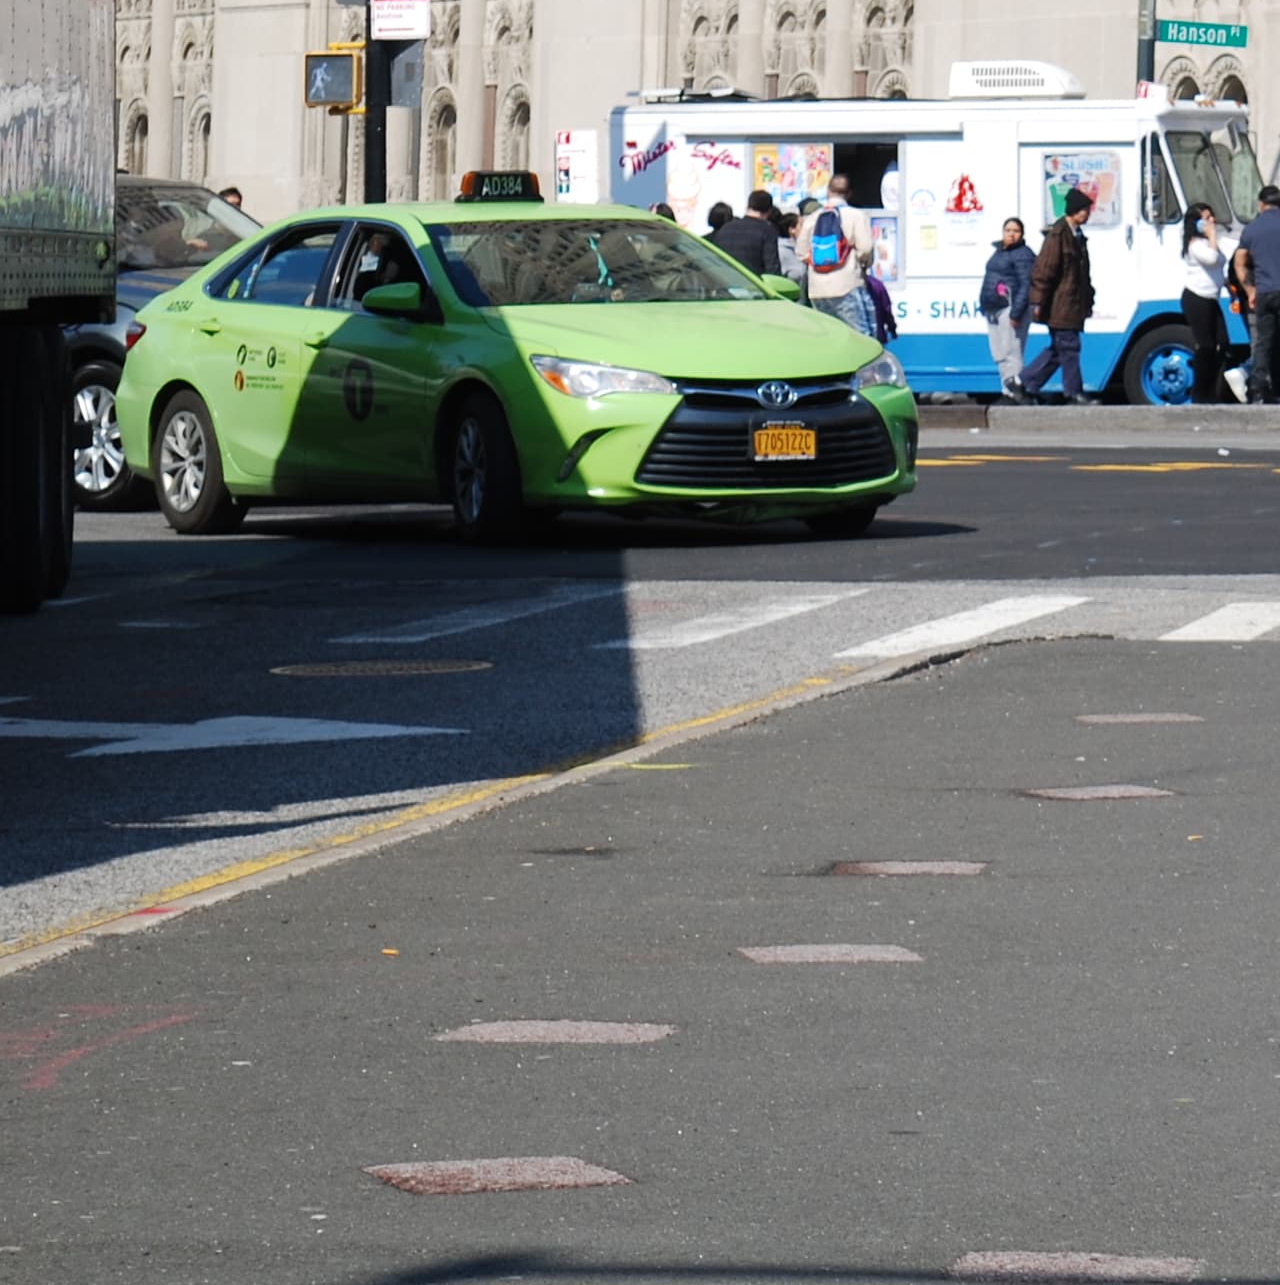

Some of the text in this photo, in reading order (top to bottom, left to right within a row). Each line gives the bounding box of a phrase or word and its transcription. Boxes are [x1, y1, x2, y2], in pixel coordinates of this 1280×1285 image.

[1167, 23, 1227, 44] Hanson
[619, 140, 678, 176] Mister
[481, 175, 523, 196] AD384
